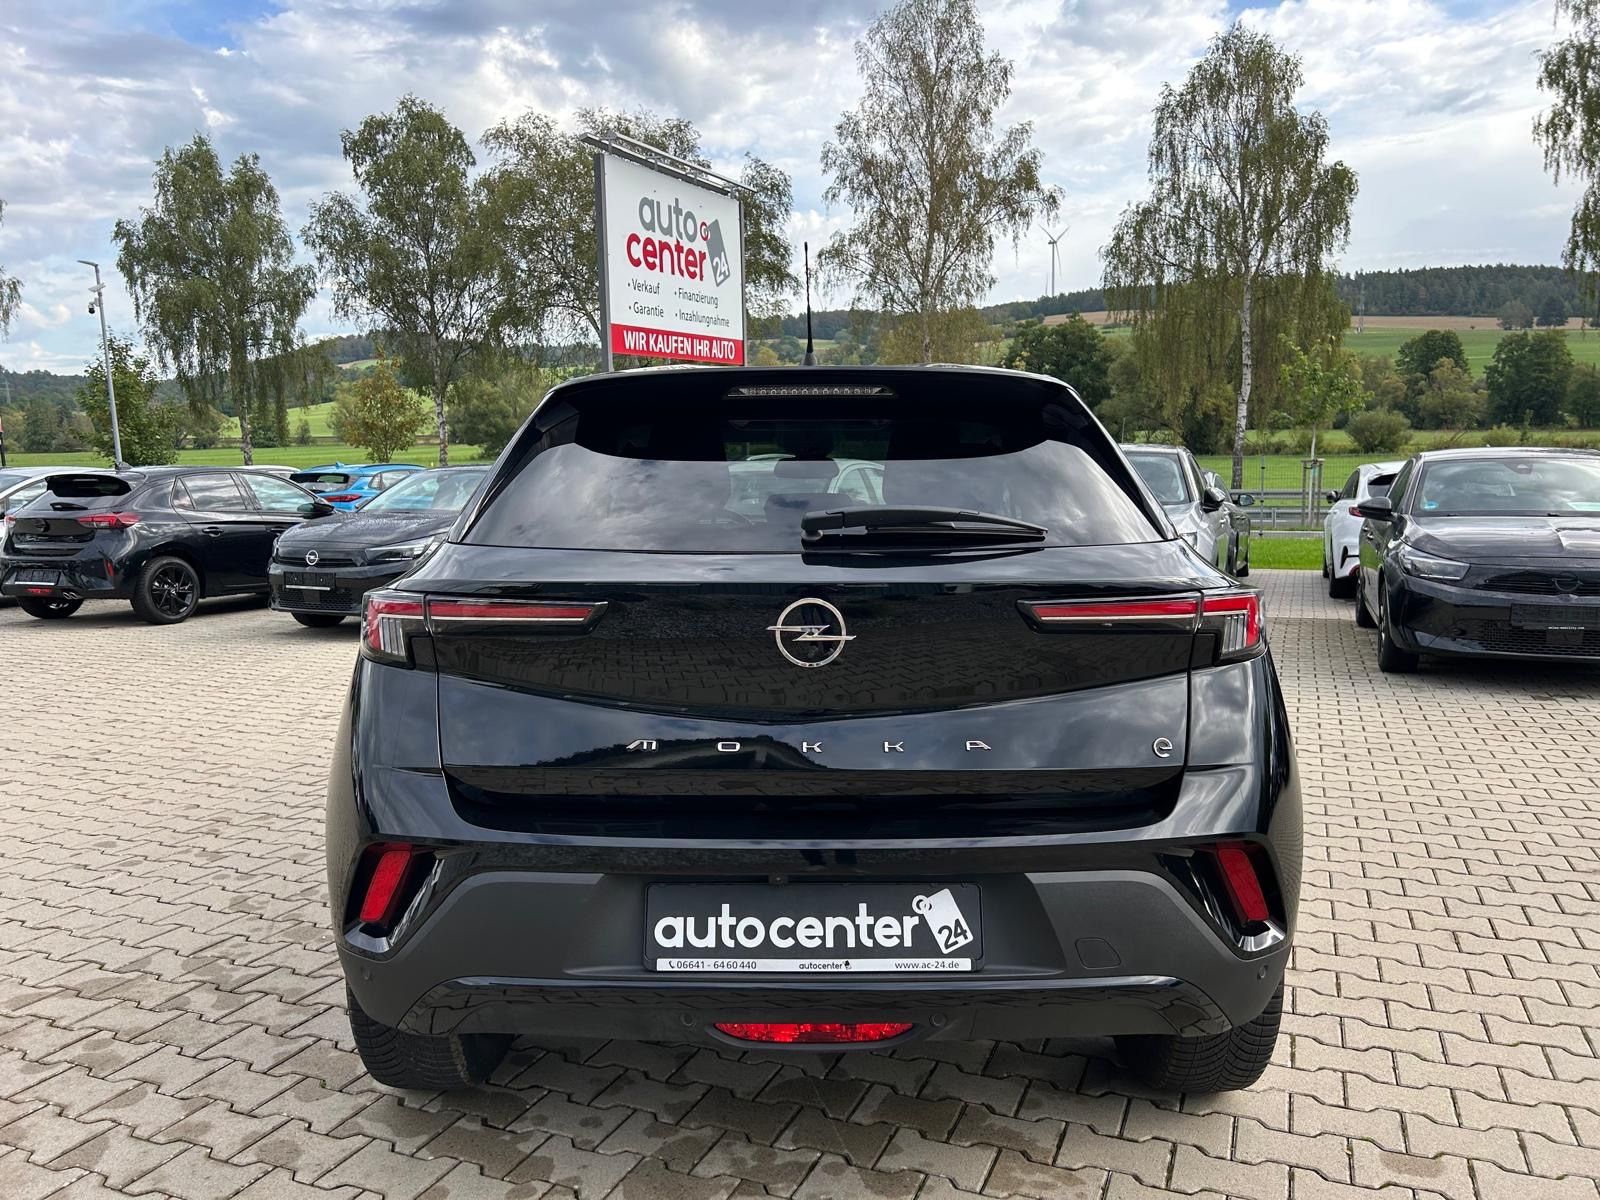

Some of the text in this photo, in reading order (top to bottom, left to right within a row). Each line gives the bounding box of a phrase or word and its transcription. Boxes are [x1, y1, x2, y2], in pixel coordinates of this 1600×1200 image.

[639, 197, 698, 243] auto
[626, 233, 707, 281] center
[712, 251, 729, 281] 24
[631, 278, 660, 295] Verkauf
[678, 287, 719, 309] Finanzierung
[633, 301, 664, 318] Garantie
[679, 308, 730, 328] Inzahlungnahme
[623, 330, 735, 360] WIR KAUFEN IHR AUTO
[626, 738, 992, 753] MOKKA
[937, 918, 969, 950] 24
[676, 960, 705, 970] 06641
[799, 961, 843, 970] autocenter
[894, 961, 960, 970] www.ac-24.de
